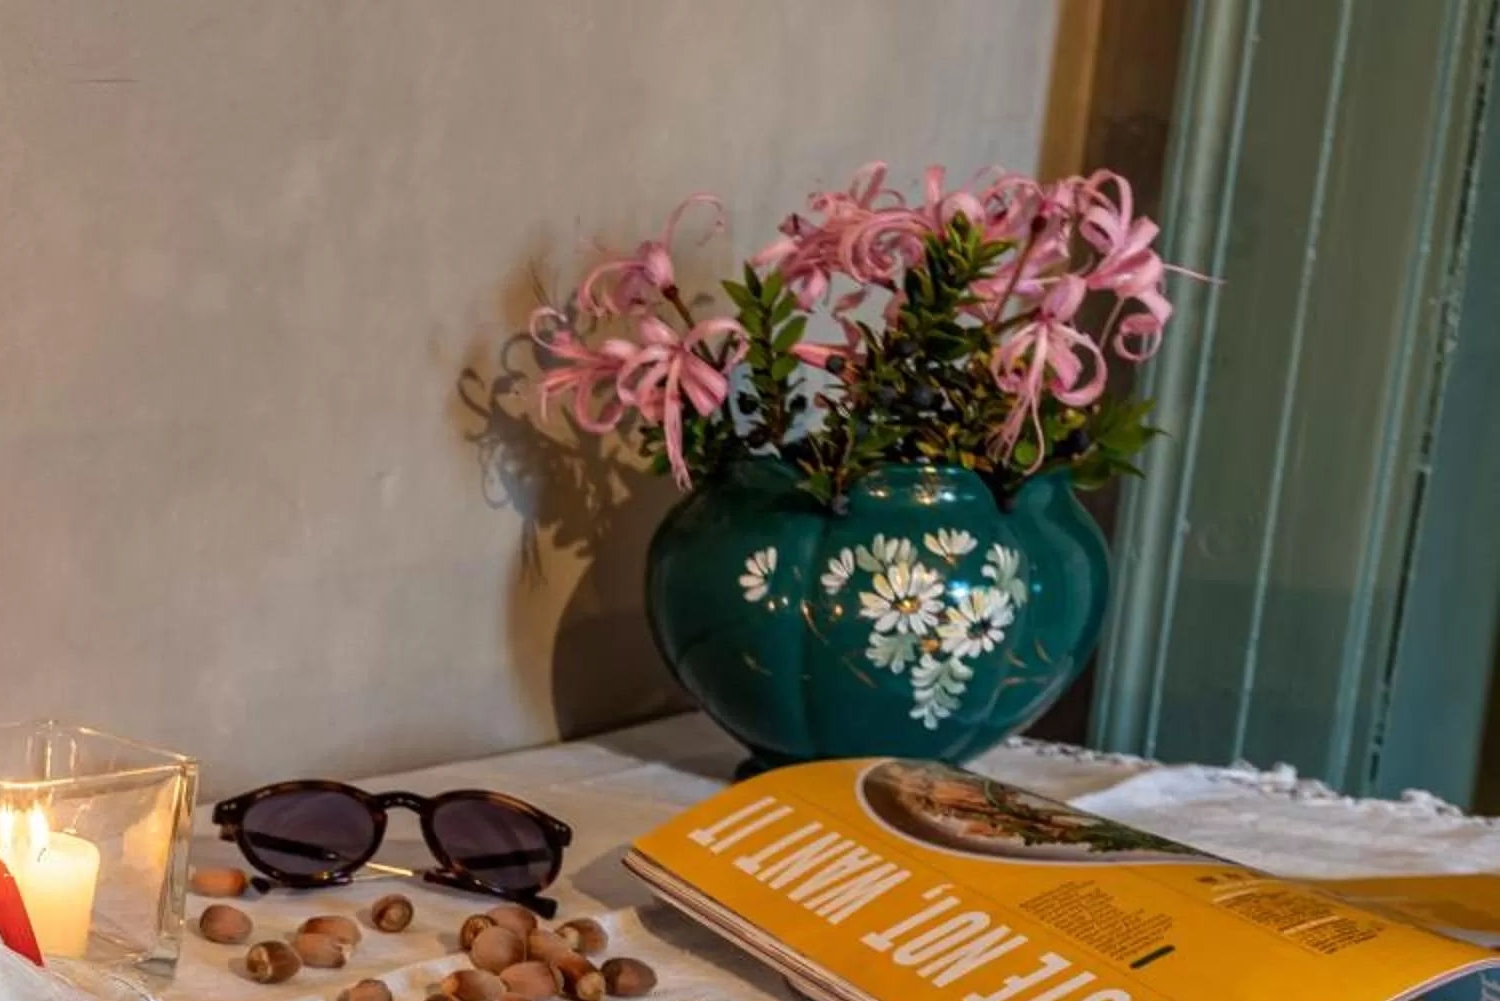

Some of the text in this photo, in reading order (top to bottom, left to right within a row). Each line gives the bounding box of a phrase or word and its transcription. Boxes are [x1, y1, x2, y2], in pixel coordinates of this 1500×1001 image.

[686, 796, 795, 855] IT
[732, 820, 912, 925] WANT
[859, 884, 1029, 988] NOT,
